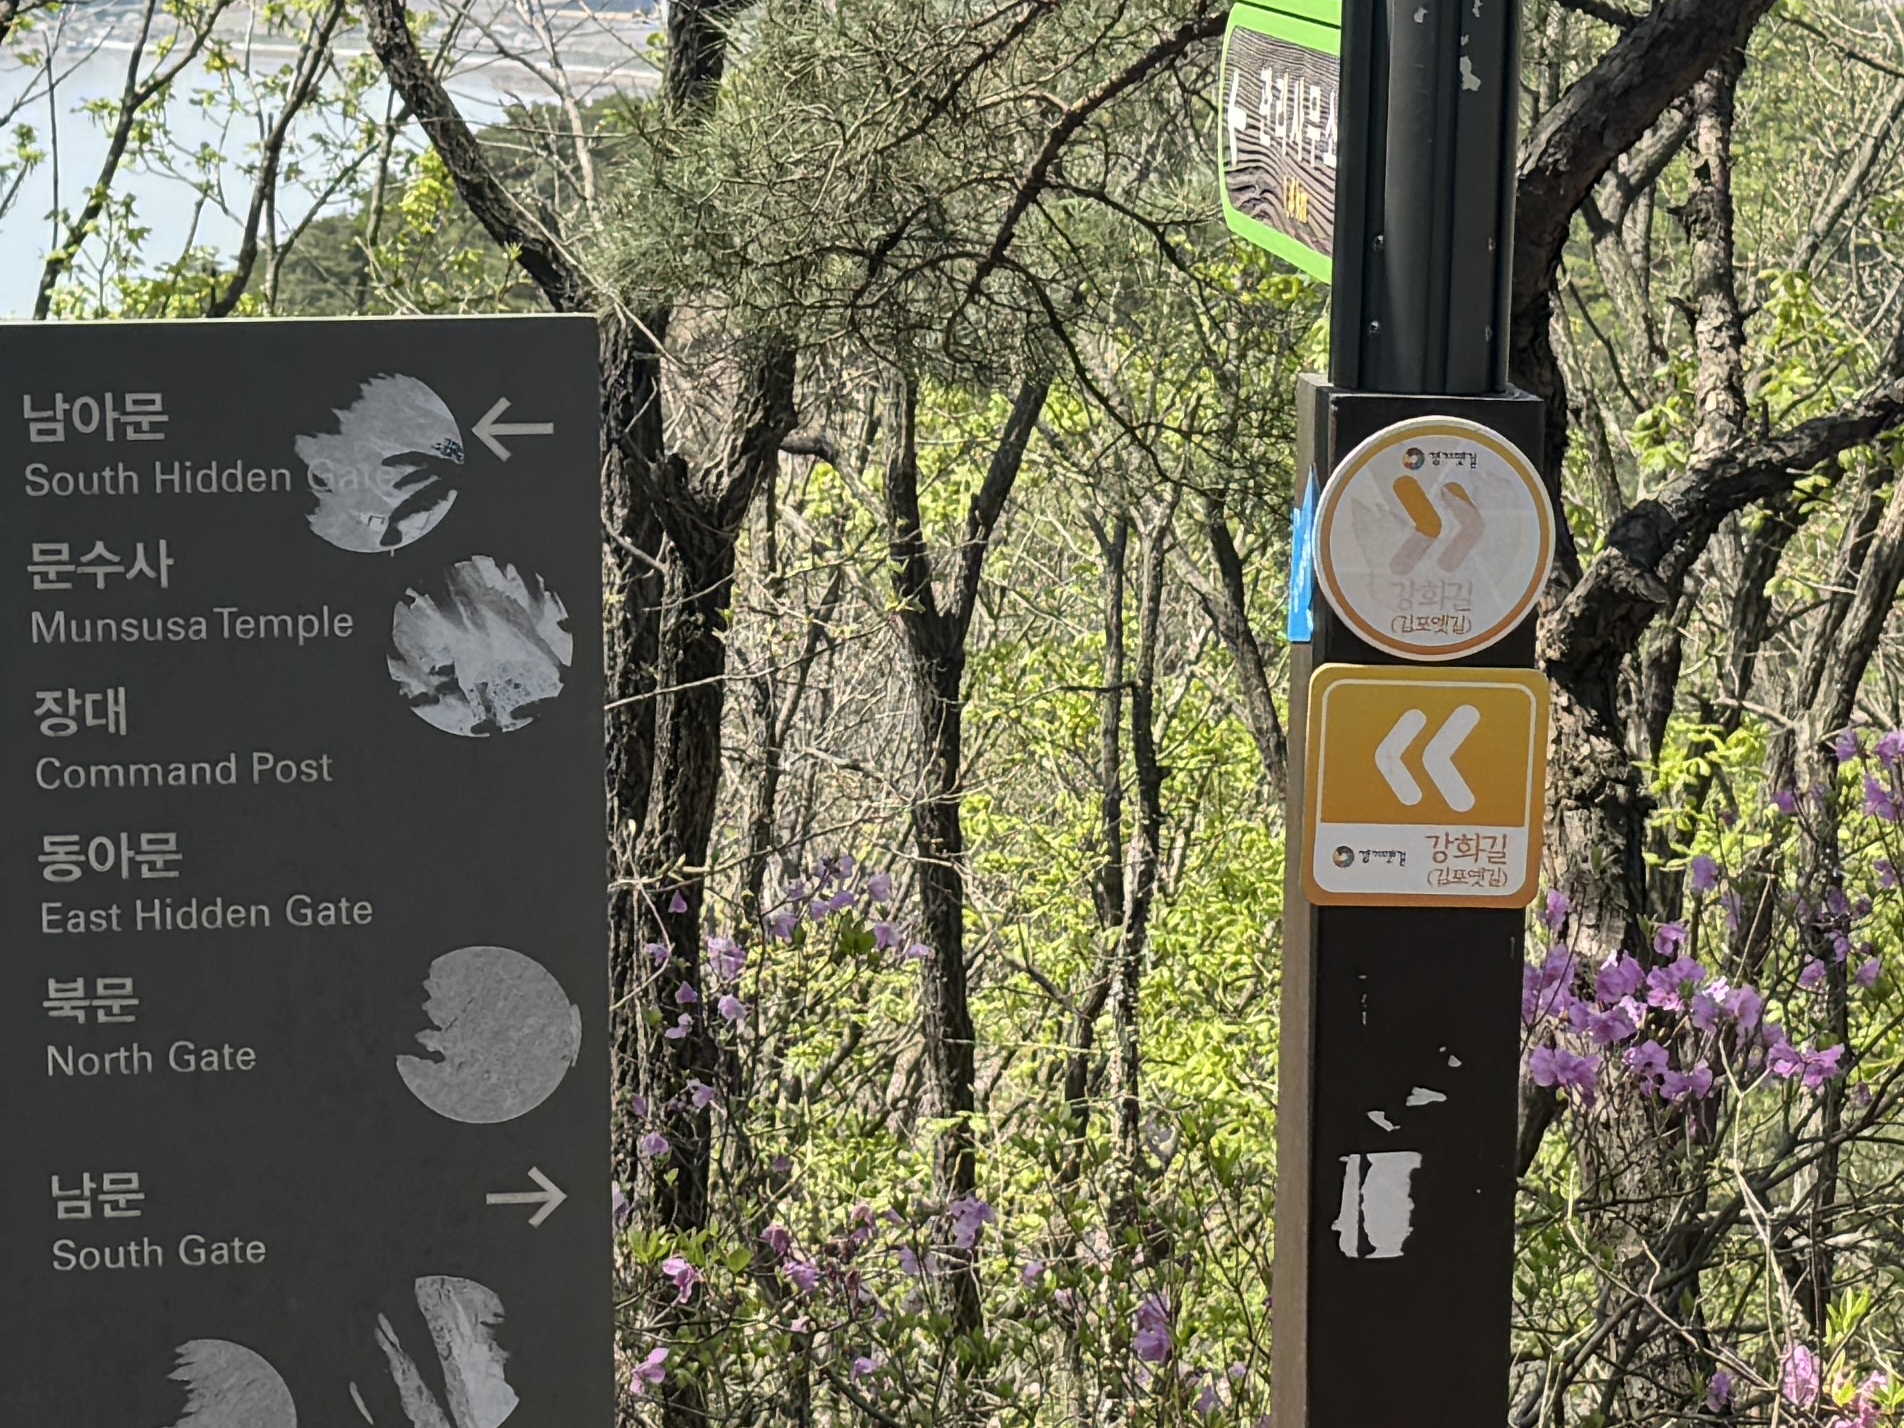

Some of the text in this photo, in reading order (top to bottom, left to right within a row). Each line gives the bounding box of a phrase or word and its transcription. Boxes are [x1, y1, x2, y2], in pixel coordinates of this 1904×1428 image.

[23, 391, 169, 443] 남아문
[25, 461, 139, 497] South
[155, 459, 291, 494] Hidden
[26, 539, 175, 590] 문수사
[1390, 579, 1473, 612] 강화길
[31, 605, 354, 646] Munsusa Temple
[33, 686, 127, 737] 장대
[35, 751, 333, 790] Command Post
[37, 831, 183, 882] 동아문
[1425, 831, 1508, 865] 강화길
[41, 894, 373, 934] East Hidden Gate
[42, 977, 140, 1024] 북문
[47, 1040, 256, 1077] North Gate
[51, 1172, 145, 1220] 남문
[52, 1234, 266, 1271] South Gate
